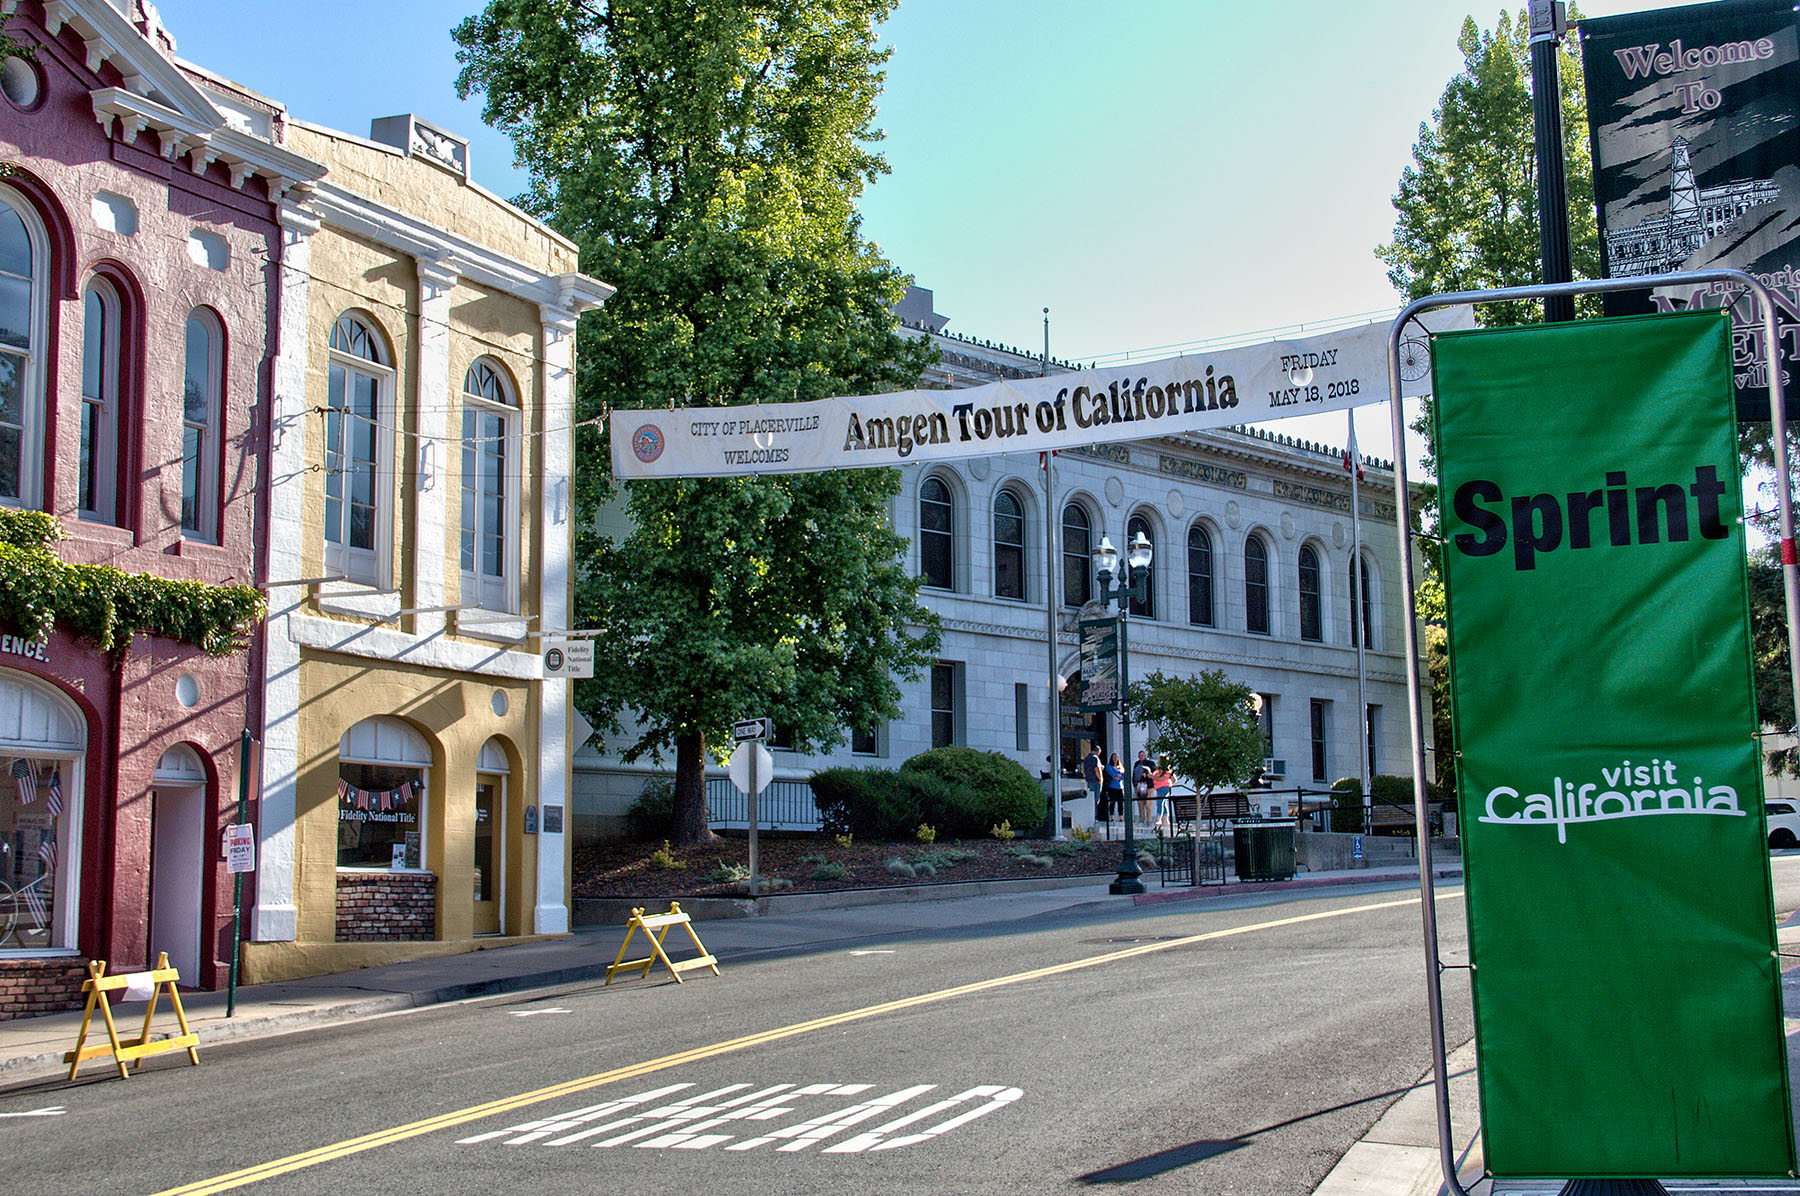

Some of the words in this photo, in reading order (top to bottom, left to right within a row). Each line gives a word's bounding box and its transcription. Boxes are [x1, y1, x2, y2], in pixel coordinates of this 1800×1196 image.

[1614, 38, 1774, 80] Welcome
[1673, 82, 1721, 114] To
[1280, 349, 1338, 372] FRIDAY
[1269, 388, 1300, 407] MAY
[1304, 386, 1323, 404] 18,
[1328, 379, 1360, 399] 2018
[843, 411, 950, 457] Amgen
[953, 402, 1030, 441] Tour
[1036, 387, 1068, 434] of
[1073, 365, 1239, 429] California
[691, 421, 720, 436] CITY
[722, 421, 736, 435] OF
[739, 416, 820, 434] PLACERVILLE
[724, 449, 789, 465] WELCOMES
[1453, 465, 1729, 570] Sprint
[0, 634, 50, 663] ENCE.
[568, 646, 589, 654] Fidelity
[1602, 759, 1677, 787] visit
[340, 809, 367, 823] Fidelity
[369, 811, 398, 822] National
[399, 813, 415, 823] Title
[1478, 776, 1747, 844] California
[454, 1082, 1024, 1153] AHEAD
